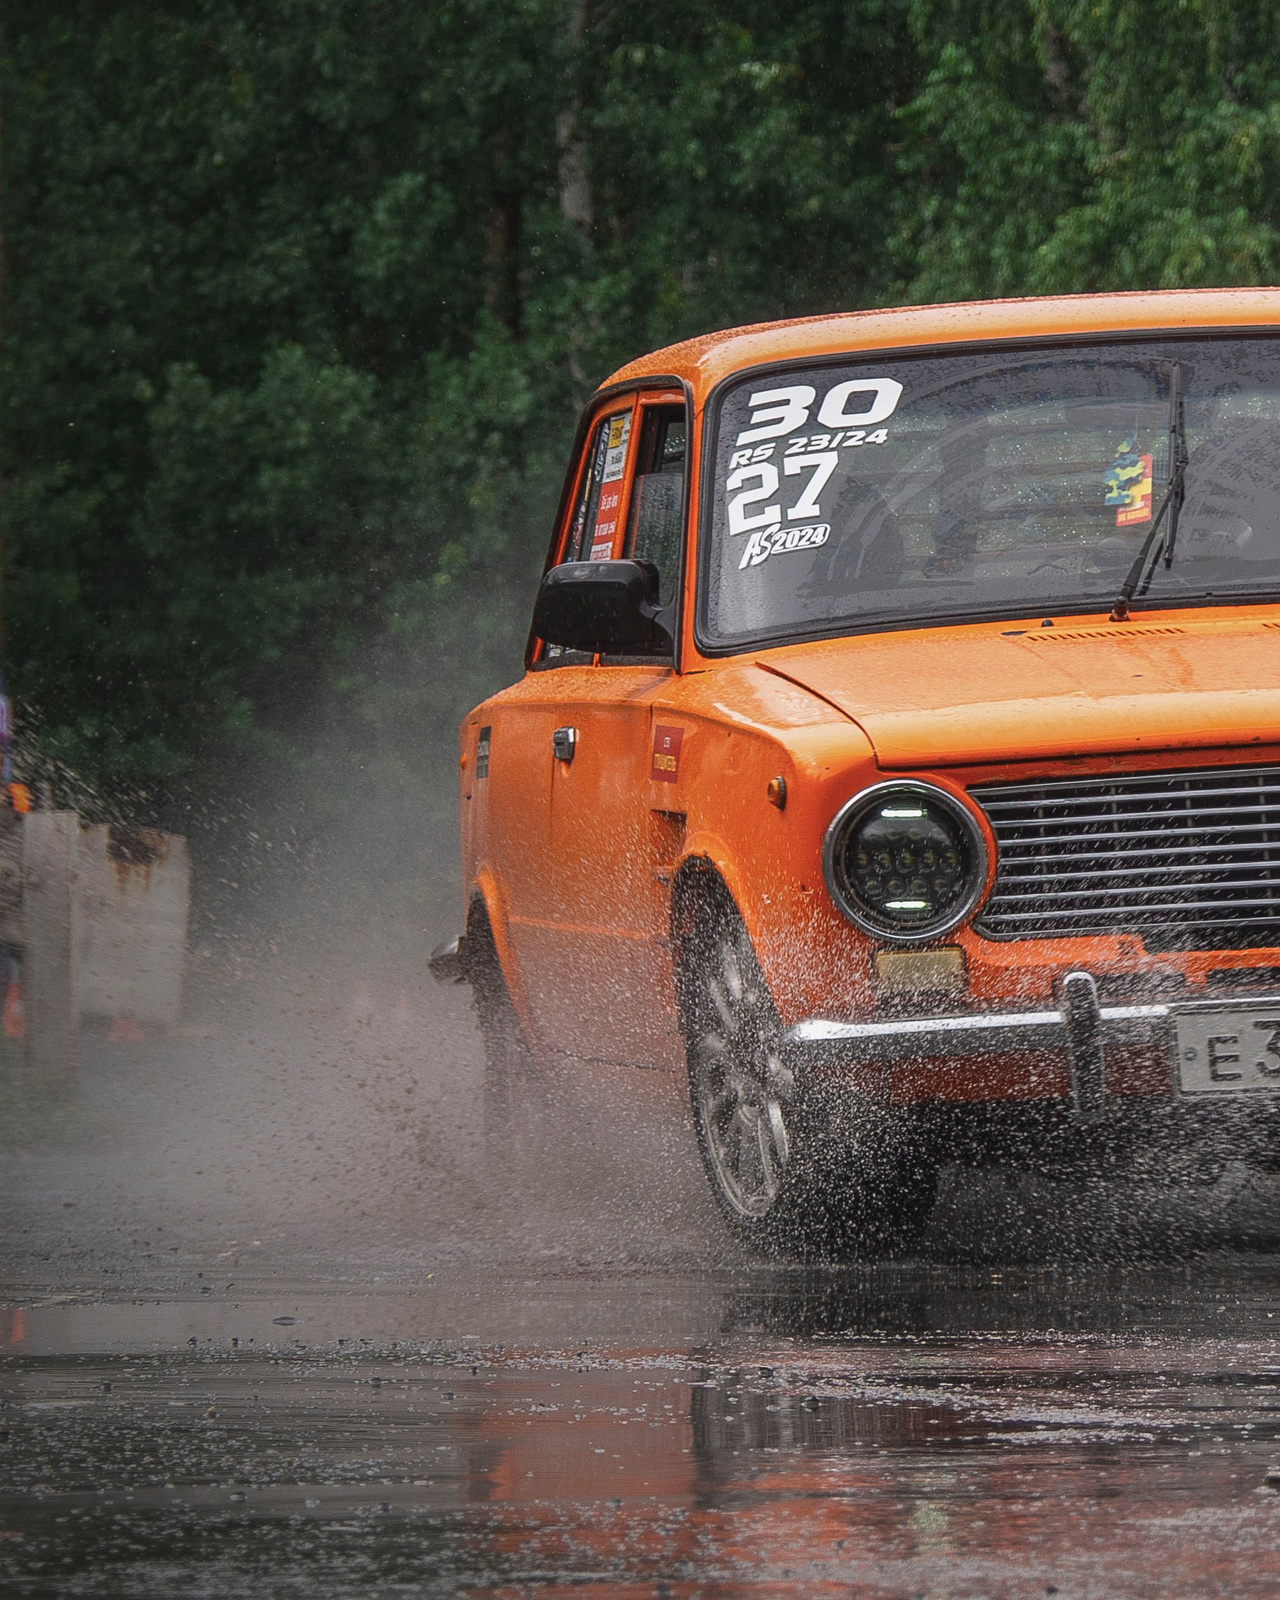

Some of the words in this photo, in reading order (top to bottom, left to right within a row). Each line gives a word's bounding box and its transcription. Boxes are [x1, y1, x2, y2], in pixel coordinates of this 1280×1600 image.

[736, 377, 904, 447] 30
[729, 442, 776, 470] RS
[785, 428, 889, 455] 23/24
[726, 451, 839, 536] 27
